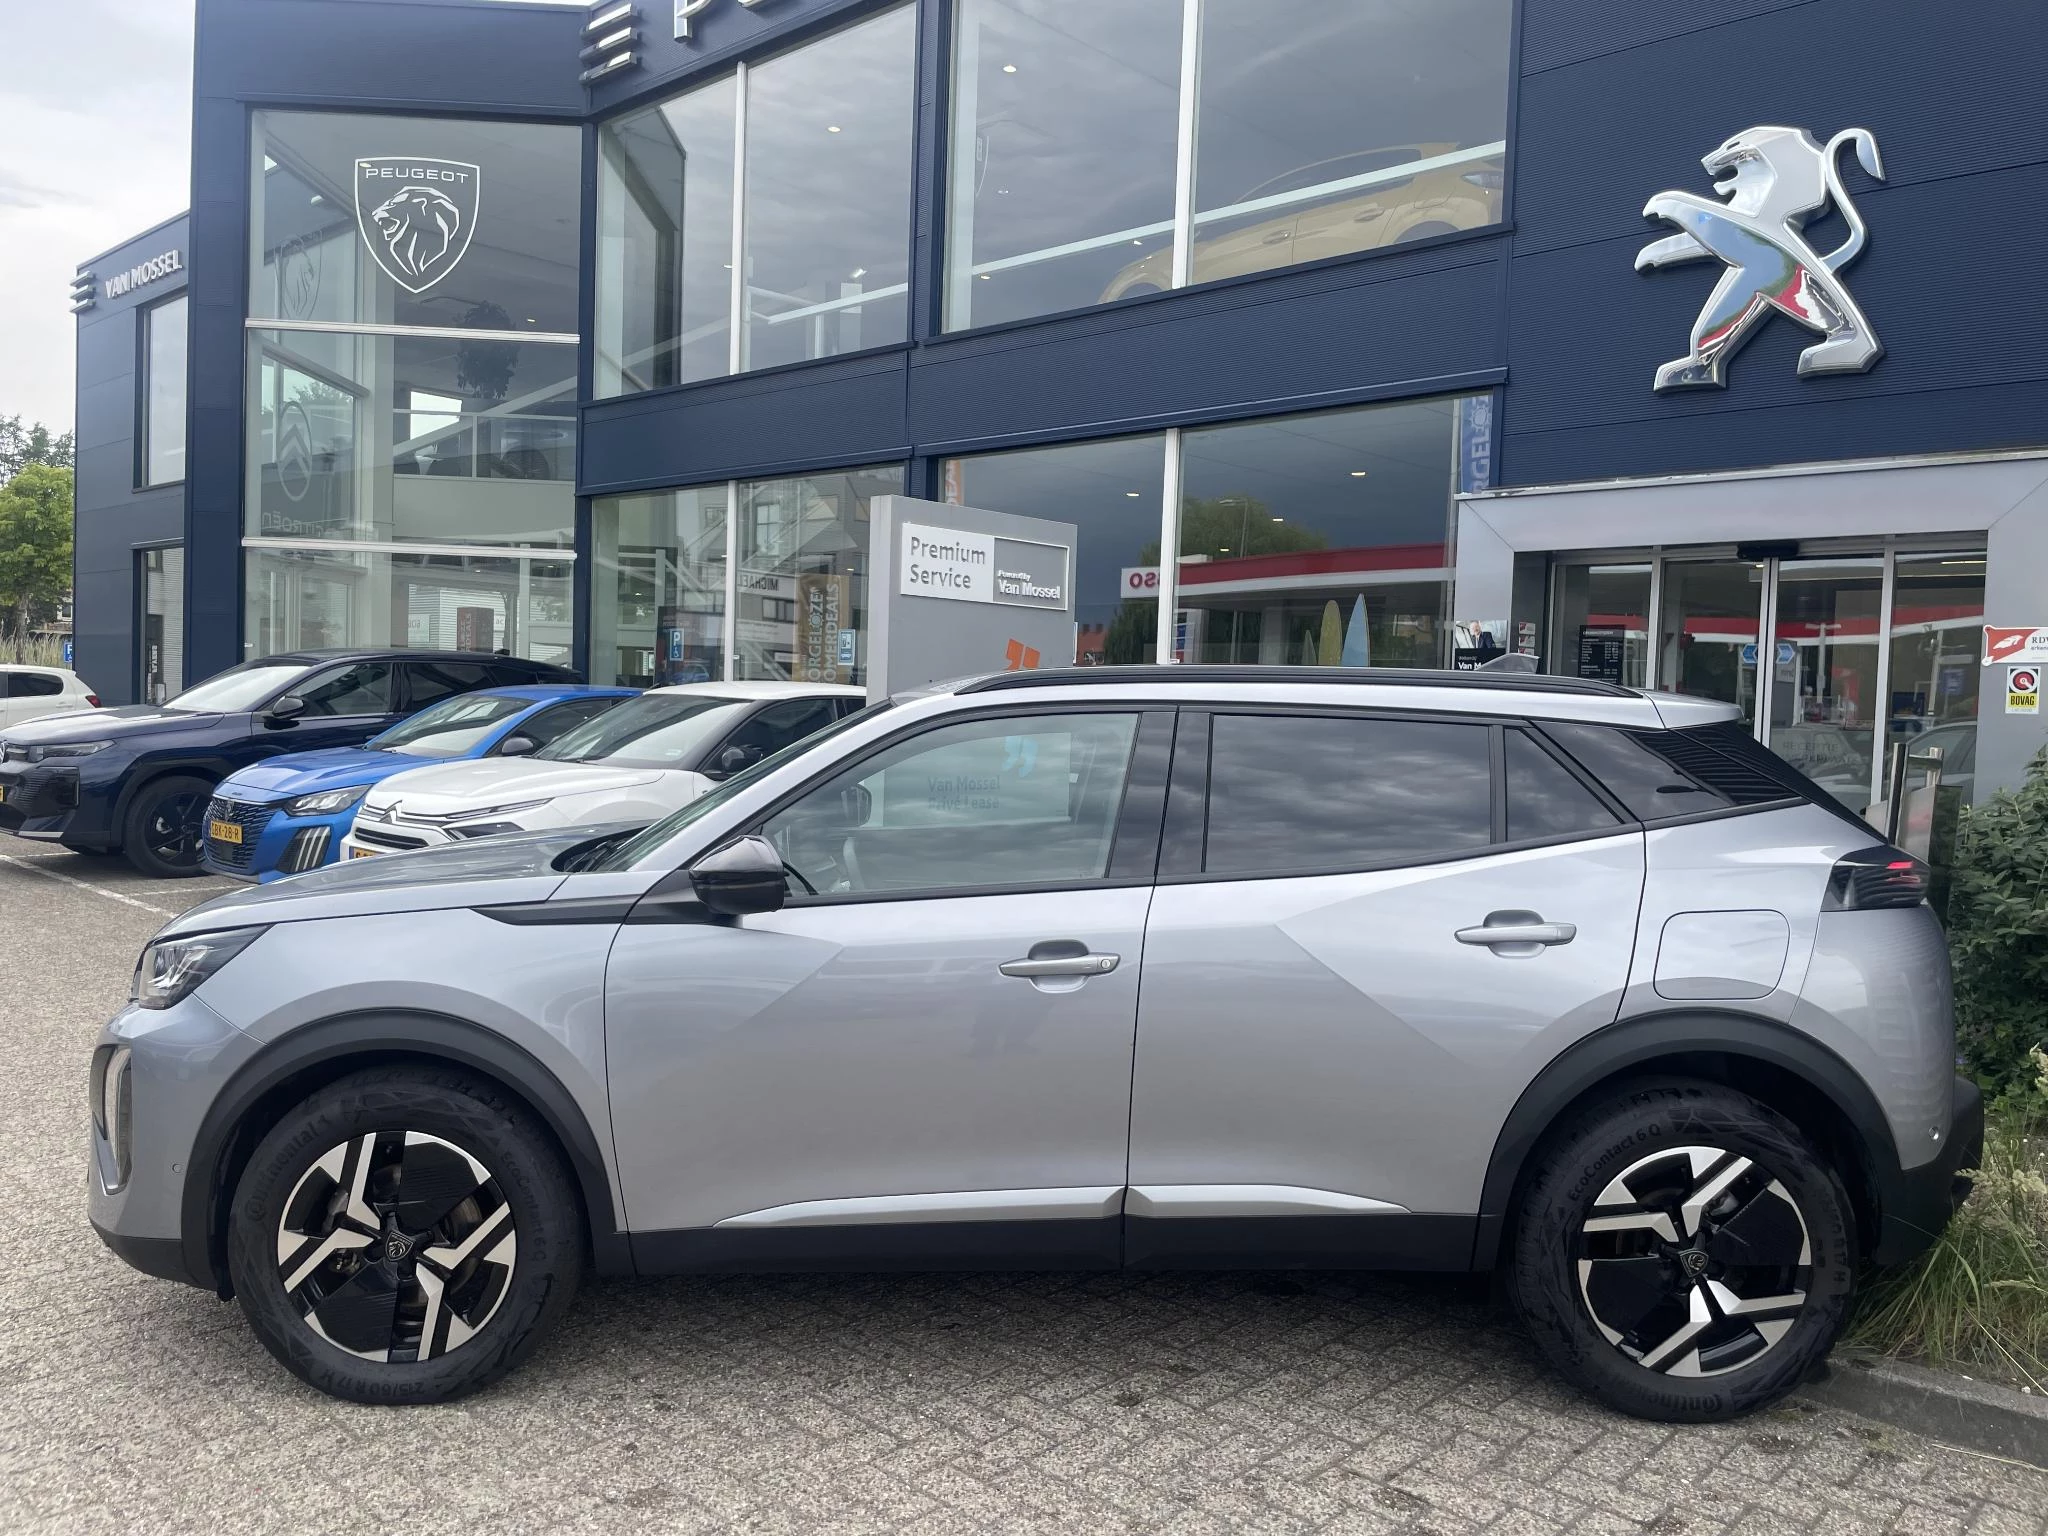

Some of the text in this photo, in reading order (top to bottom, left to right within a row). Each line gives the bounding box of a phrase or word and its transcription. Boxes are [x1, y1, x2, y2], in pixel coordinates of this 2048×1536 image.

[365, 167, 469, 184] PEUGEOT
[105, 249, 183, 299] VAN MOSSEL
[910, 536, 986, 565] Premium
[909, 564, 972, 589] Service
[999, 579, 1061, 599] Van Mossel
[673, 631, 681, 646] P
[824, 583, 840, 681] OMERDEALS
[1458, 662, 1472, 670] Van
[2010, 695, 2035, 706] BOVAG
[1567, 1134, 1636, 1202] EcoContact
